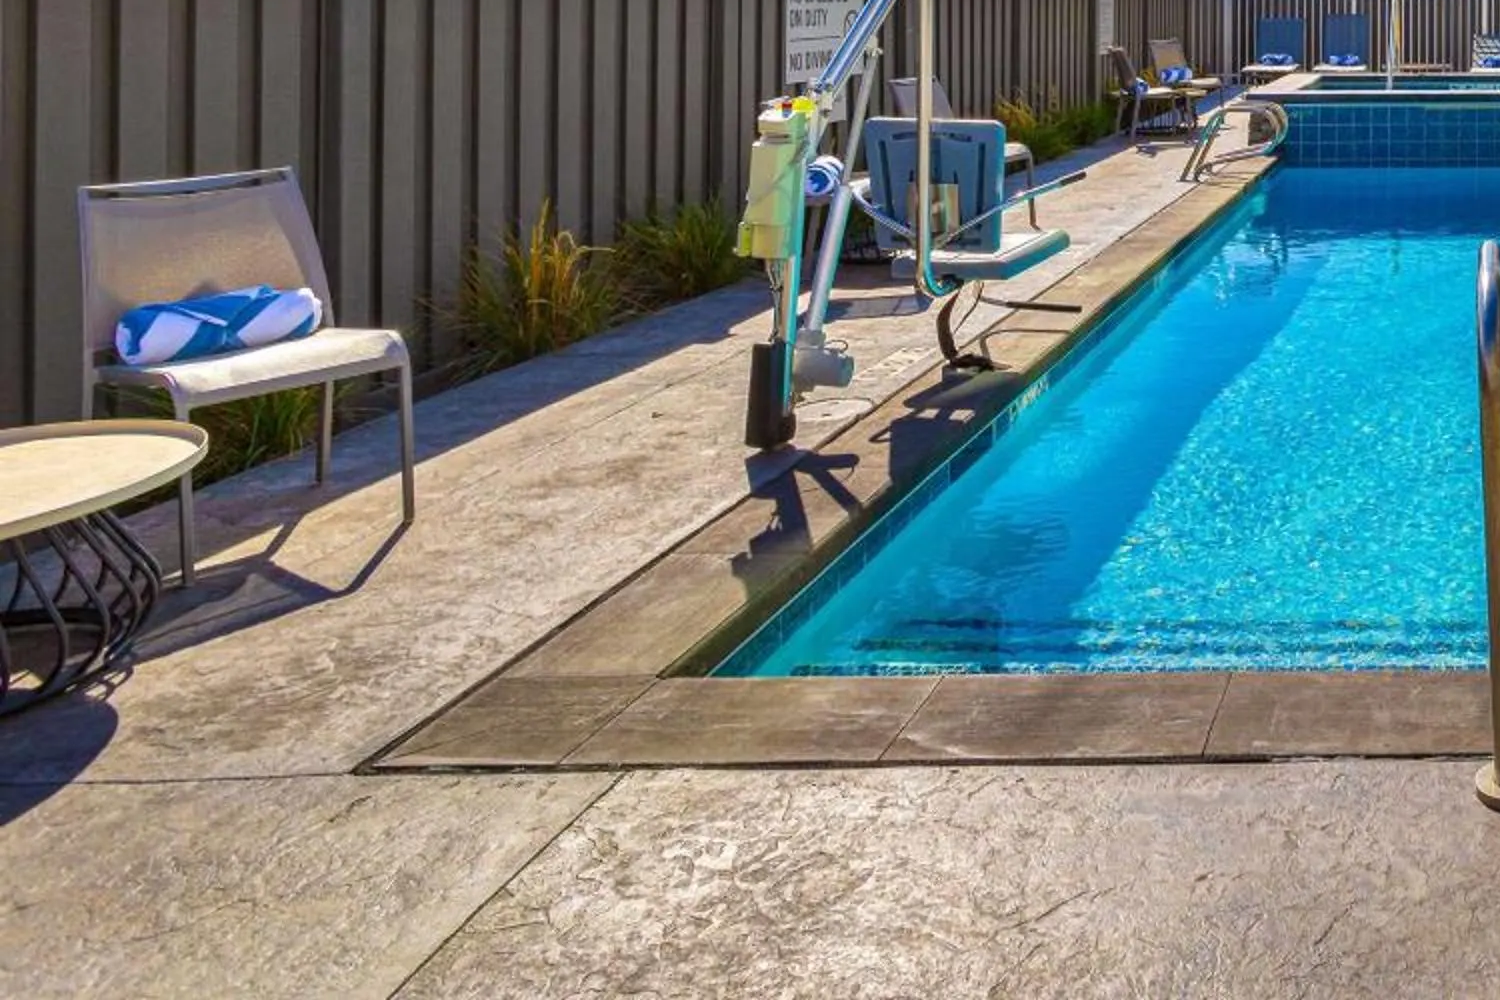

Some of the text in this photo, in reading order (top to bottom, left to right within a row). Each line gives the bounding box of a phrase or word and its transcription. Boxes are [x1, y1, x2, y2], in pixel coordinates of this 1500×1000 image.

[789, 7, 828, 28] ON DUTY
[789, 52, 803, 72] NO
